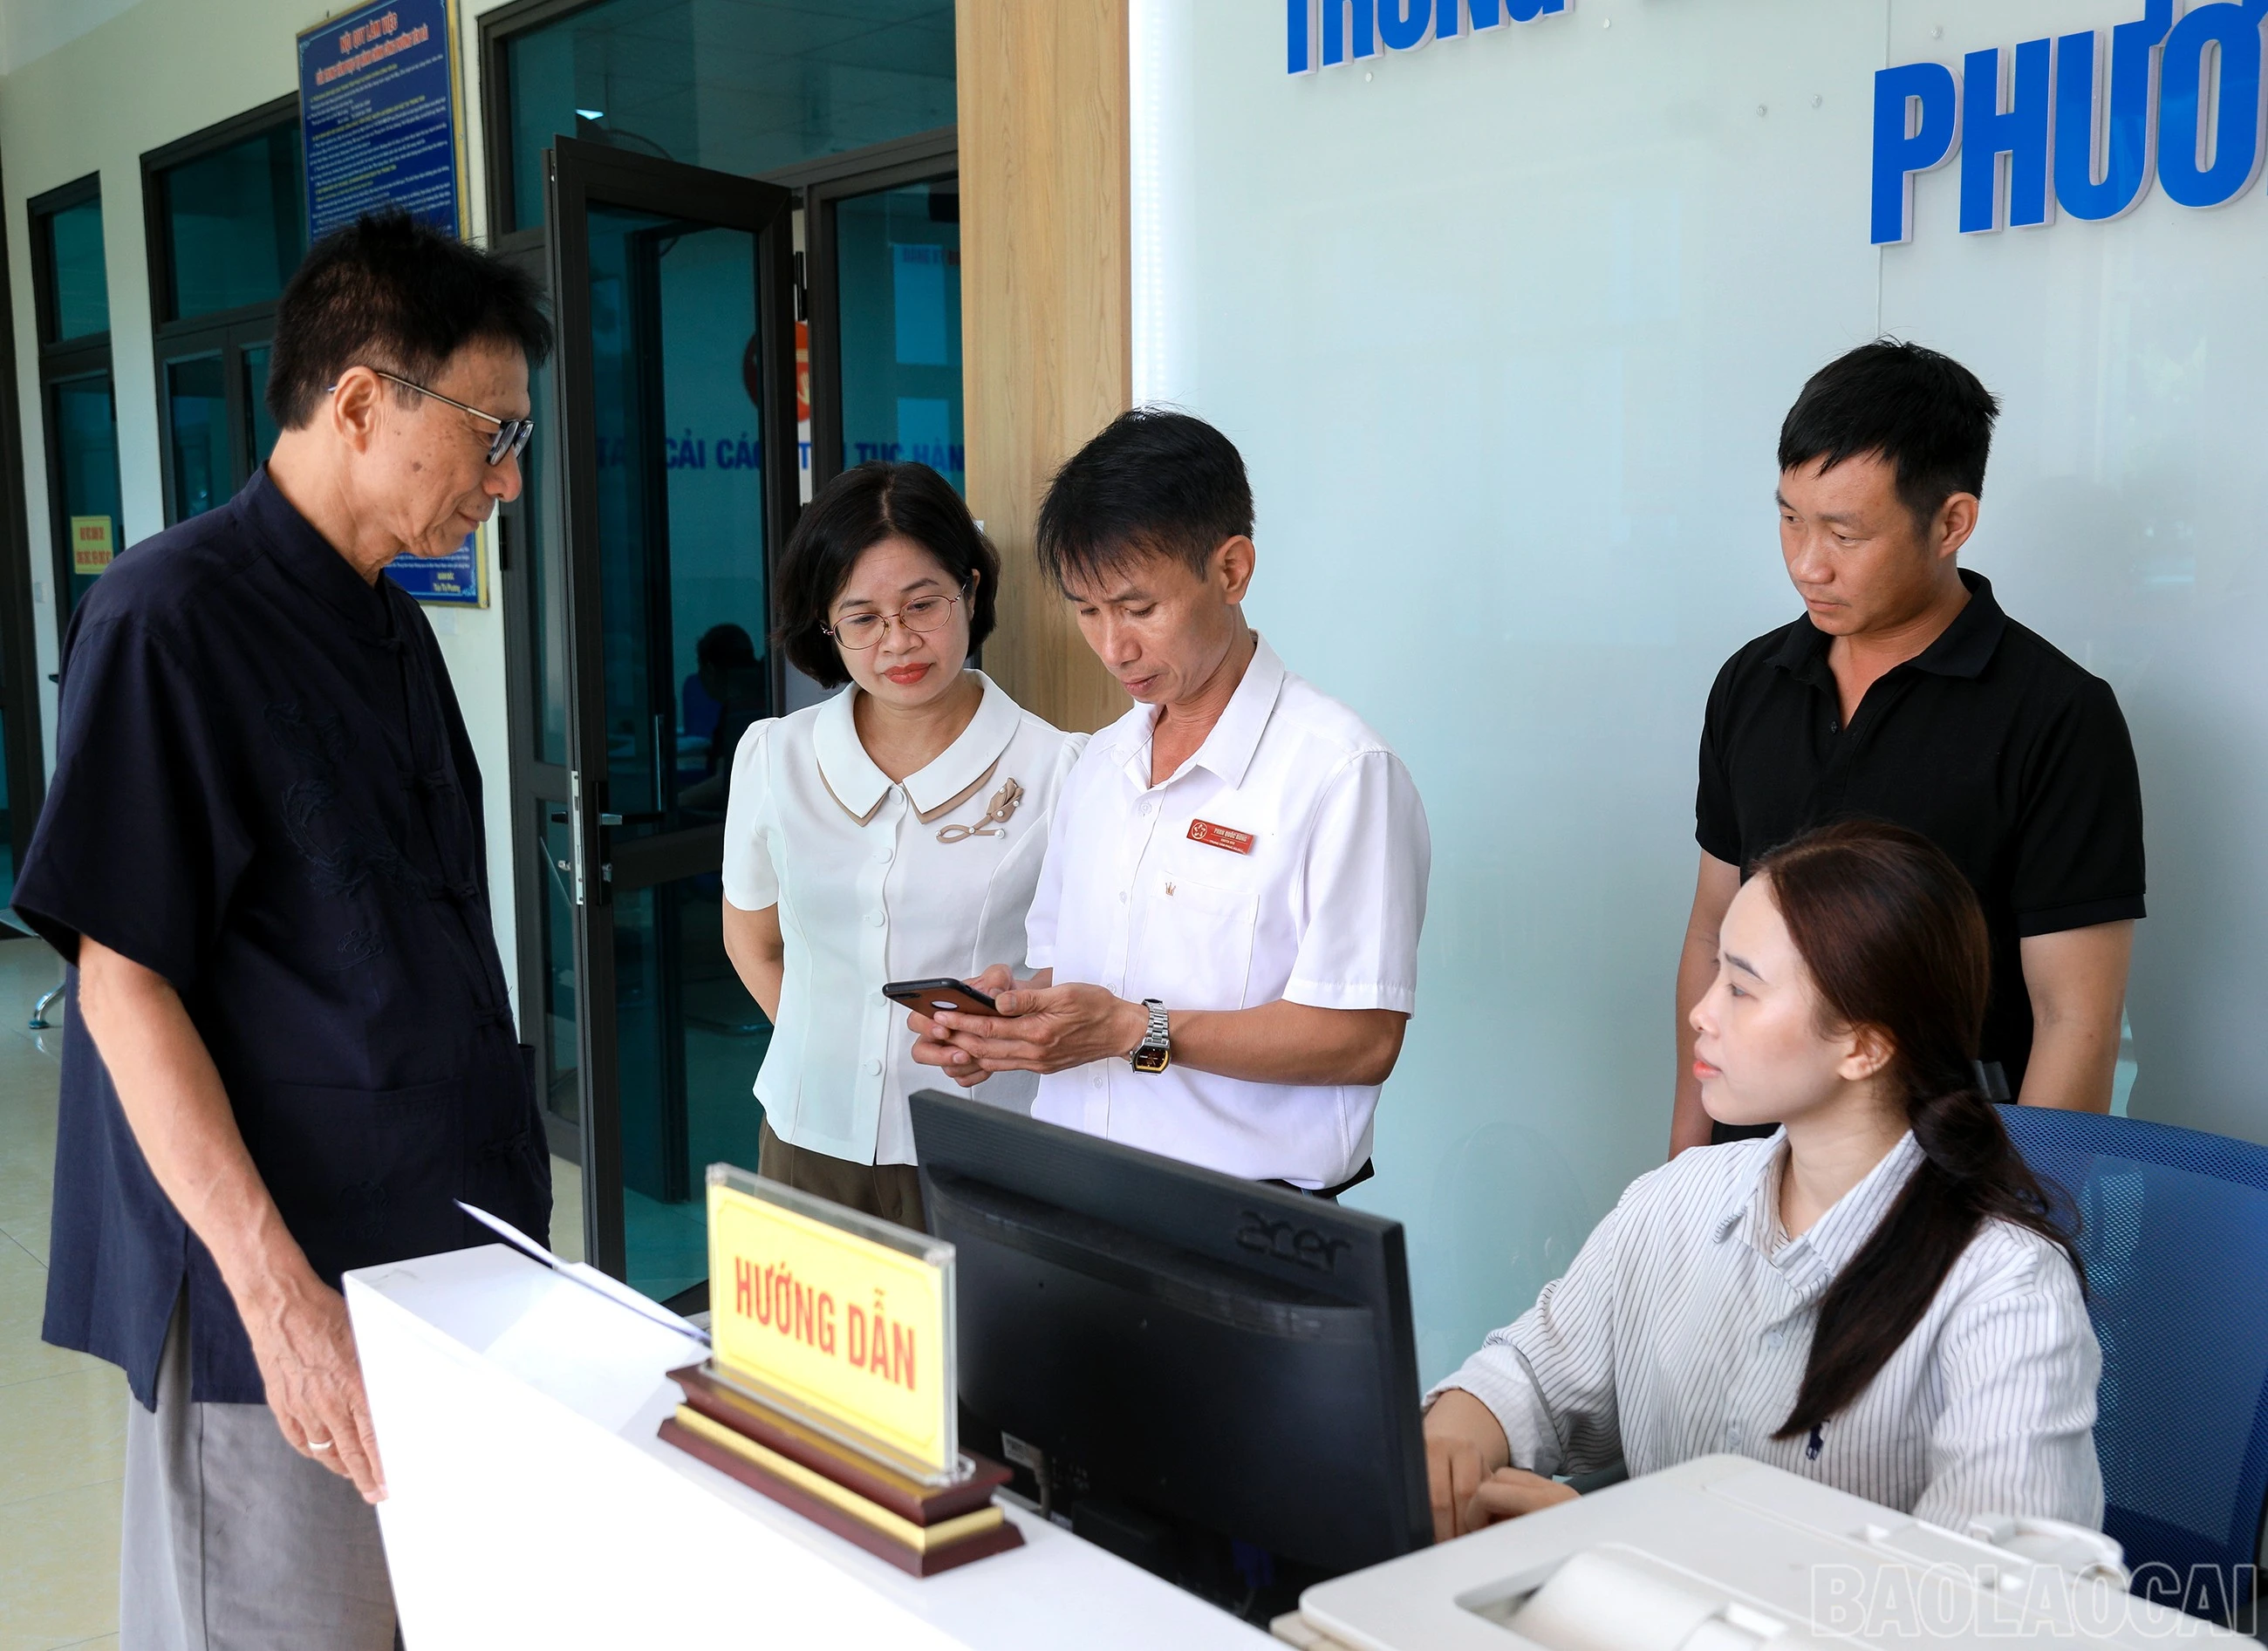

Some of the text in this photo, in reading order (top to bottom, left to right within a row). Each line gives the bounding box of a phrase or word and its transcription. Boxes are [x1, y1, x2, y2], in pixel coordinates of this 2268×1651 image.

[1236, 1210, 1351, 1274] acer
[734, 1255, 916, 1391] HƯỚNG DẪN
